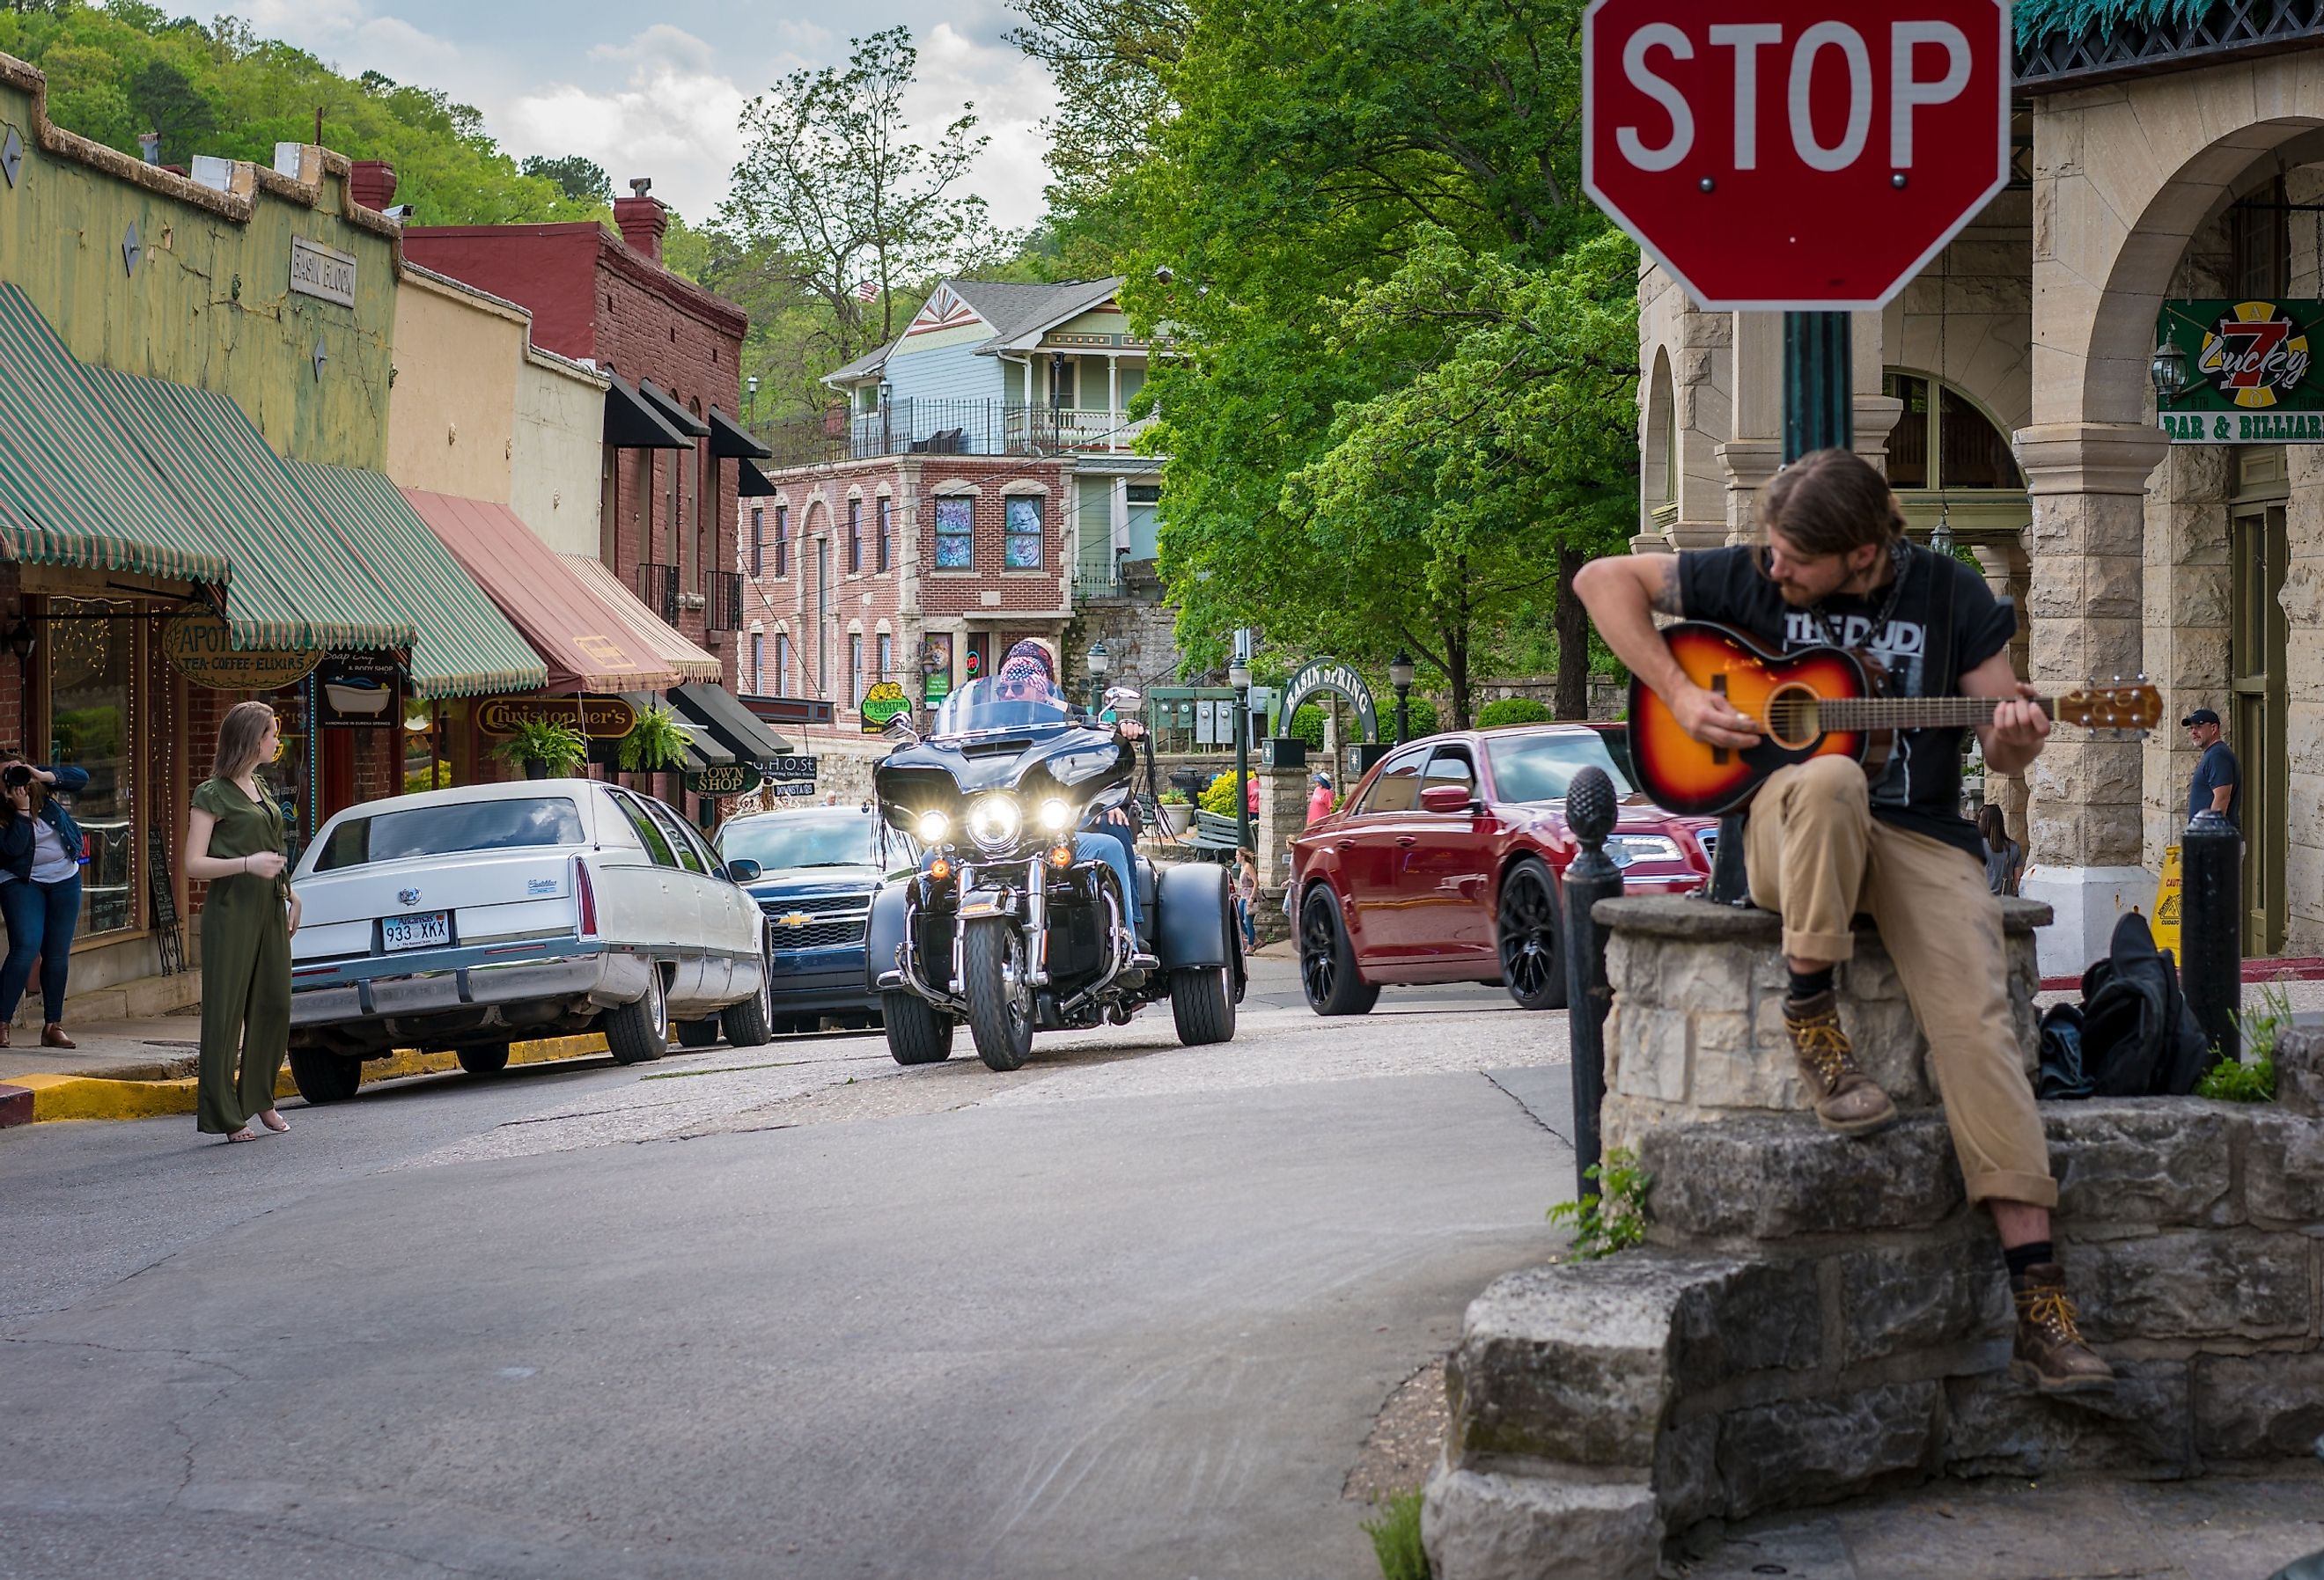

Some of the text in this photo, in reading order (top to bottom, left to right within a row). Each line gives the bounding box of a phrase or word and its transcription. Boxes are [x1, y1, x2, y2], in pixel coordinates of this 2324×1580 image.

[1616, 20, 1973, 173] STOP
[293, 249, 353, 296] BASIN BLOCK
[2198, 335, 2311, 386] Lucky
[2222, 321, 2290, 389] 7
[2164, 415, 2324, 440] BAR & BILLIAR
[1843, 615, 1926, 654] DUD
[1286, 665, 1368, 715] BASIN SPRING
[486, 702, 626, 729] Christopher's
[699, 778, 743, 790] SHOP
[2166, 878, 2181, 887] CAUT
[386, 921, 445, 942] 933 XKX
[398, 915, 434, 926] Arkansas
